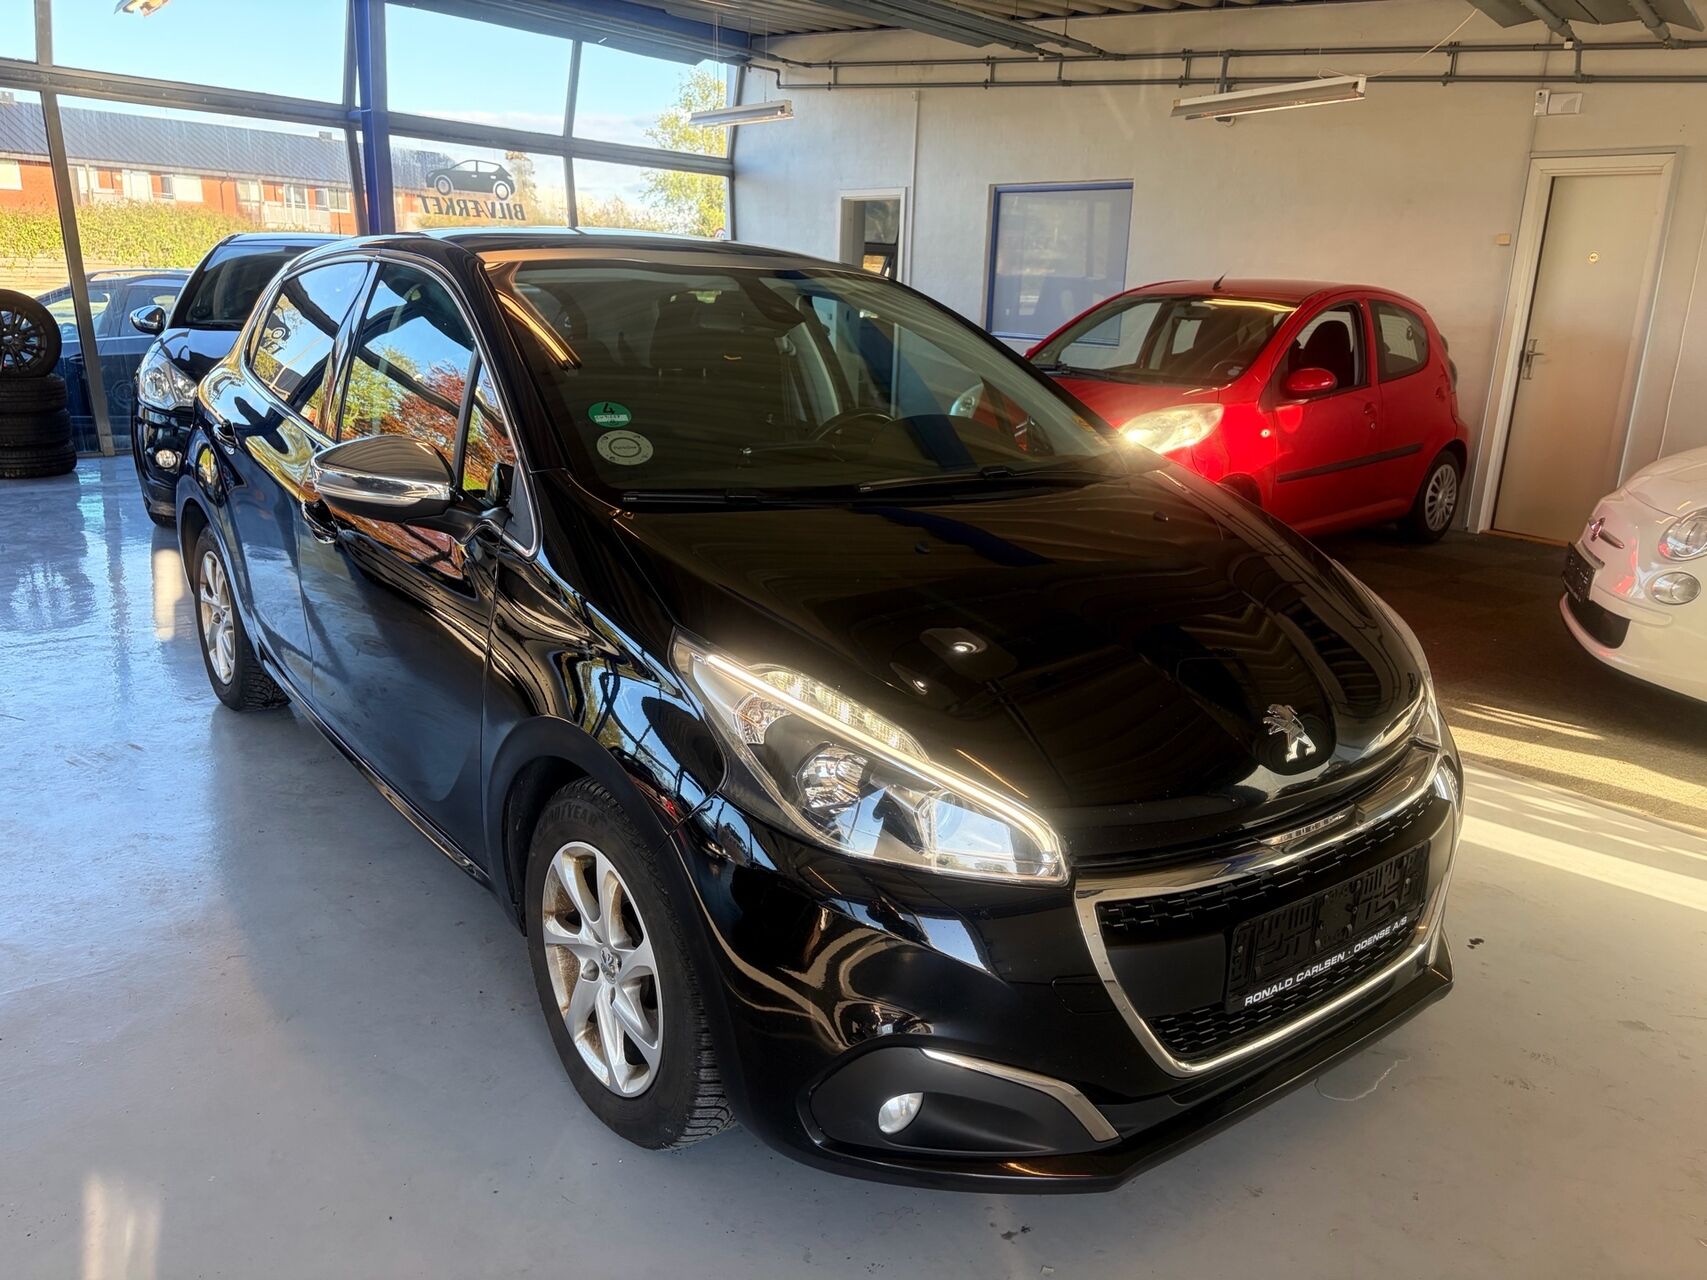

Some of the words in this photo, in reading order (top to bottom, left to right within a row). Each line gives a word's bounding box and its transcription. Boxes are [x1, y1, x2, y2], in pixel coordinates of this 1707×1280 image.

[602, 402, 615, 415] 4
[1244, 977, 1293, 1007] RONALD
[1296, 951, 1346, 983] CARLSEN
[1353, 925, 1392, 953] ODENSE
[1392, 915, 1408, 931] A/S
